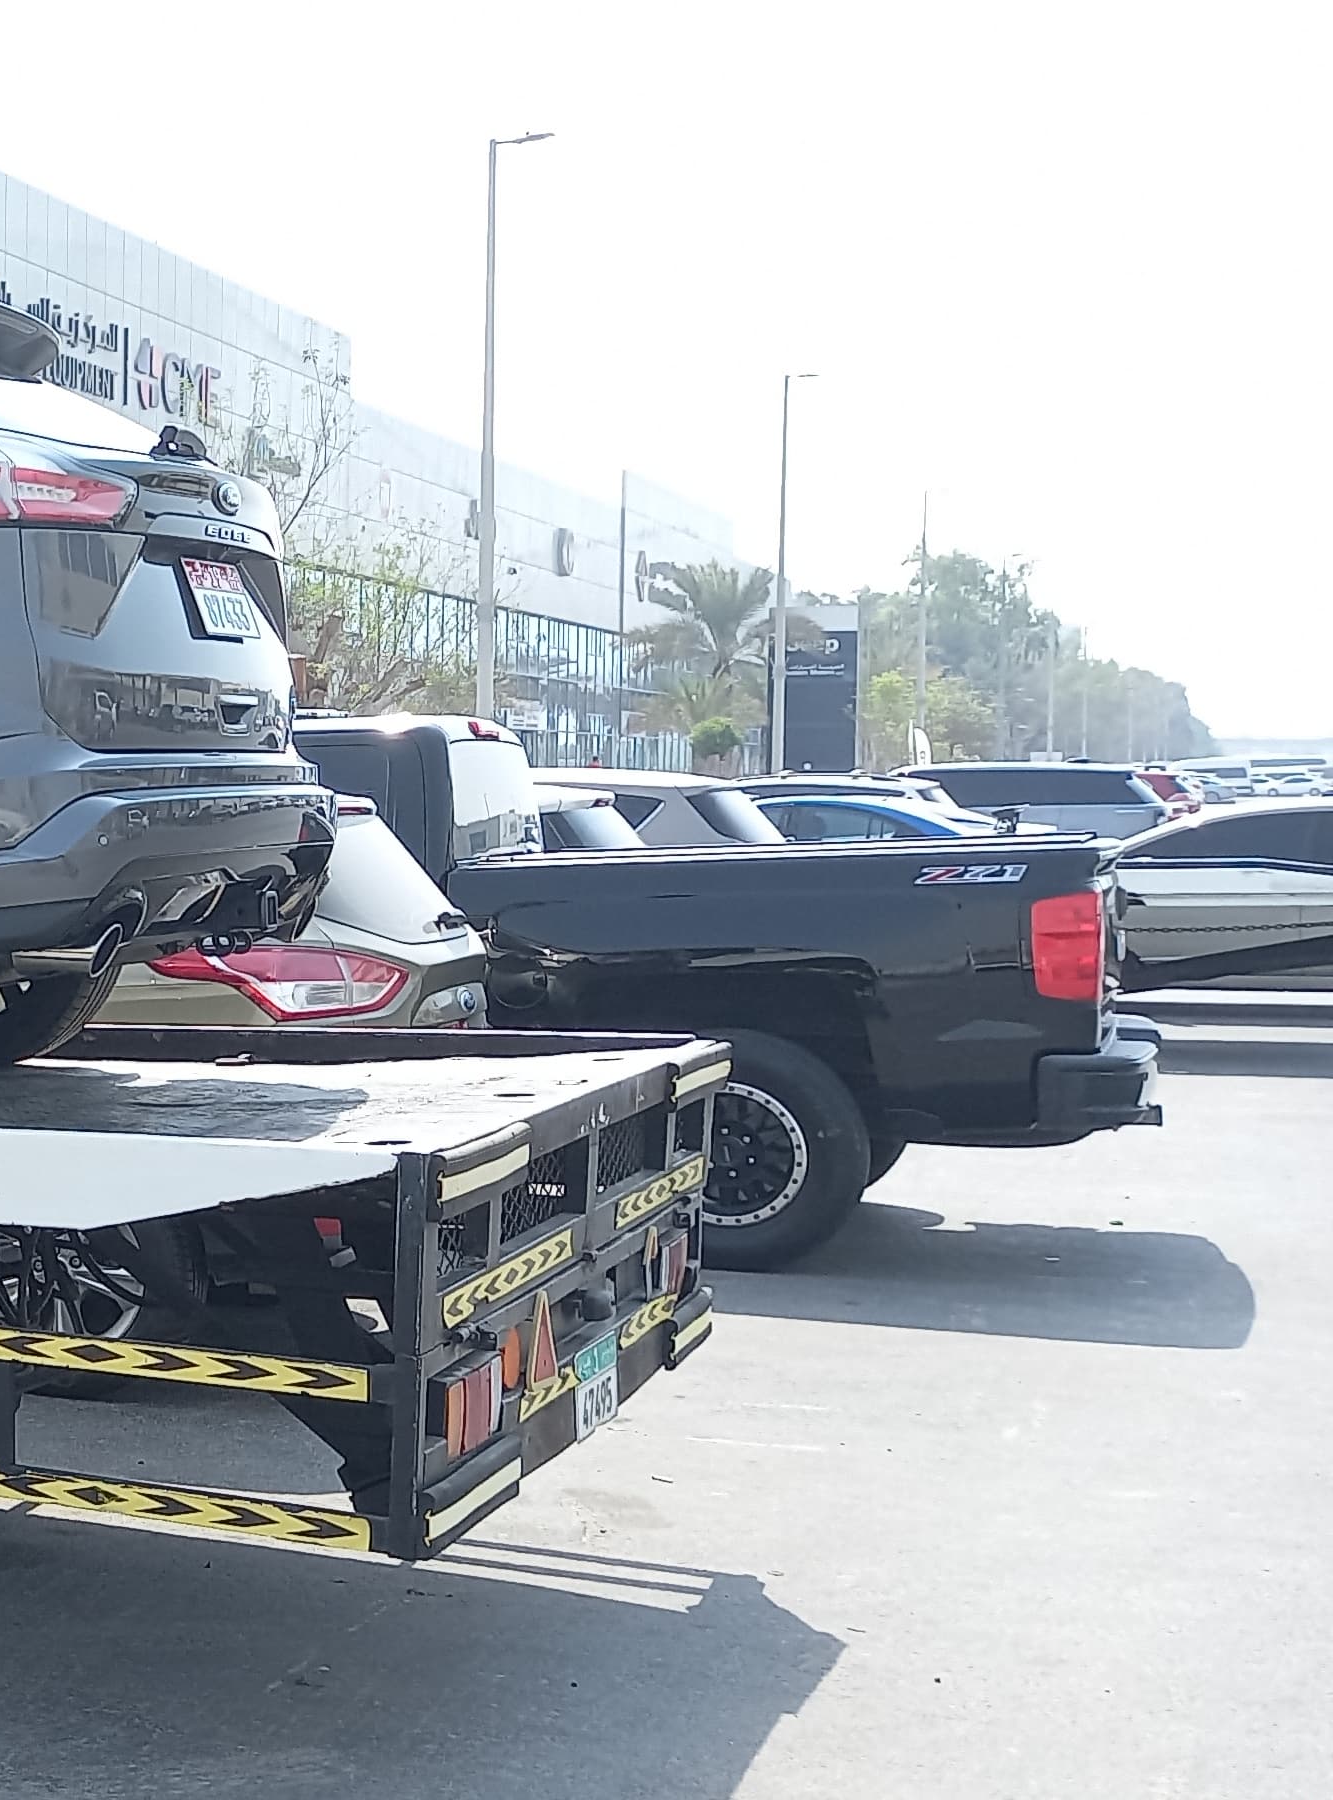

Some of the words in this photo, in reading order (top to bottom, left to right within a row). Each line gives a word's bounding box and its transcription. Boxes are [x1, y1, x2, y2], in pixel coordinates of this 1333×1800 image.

[161, 352, 222, 428] CME
[204, 523, 251, 544] EDGE
[913, 863, 1030, 887] Z71
[582, 1375, 613, 1430] 47495
